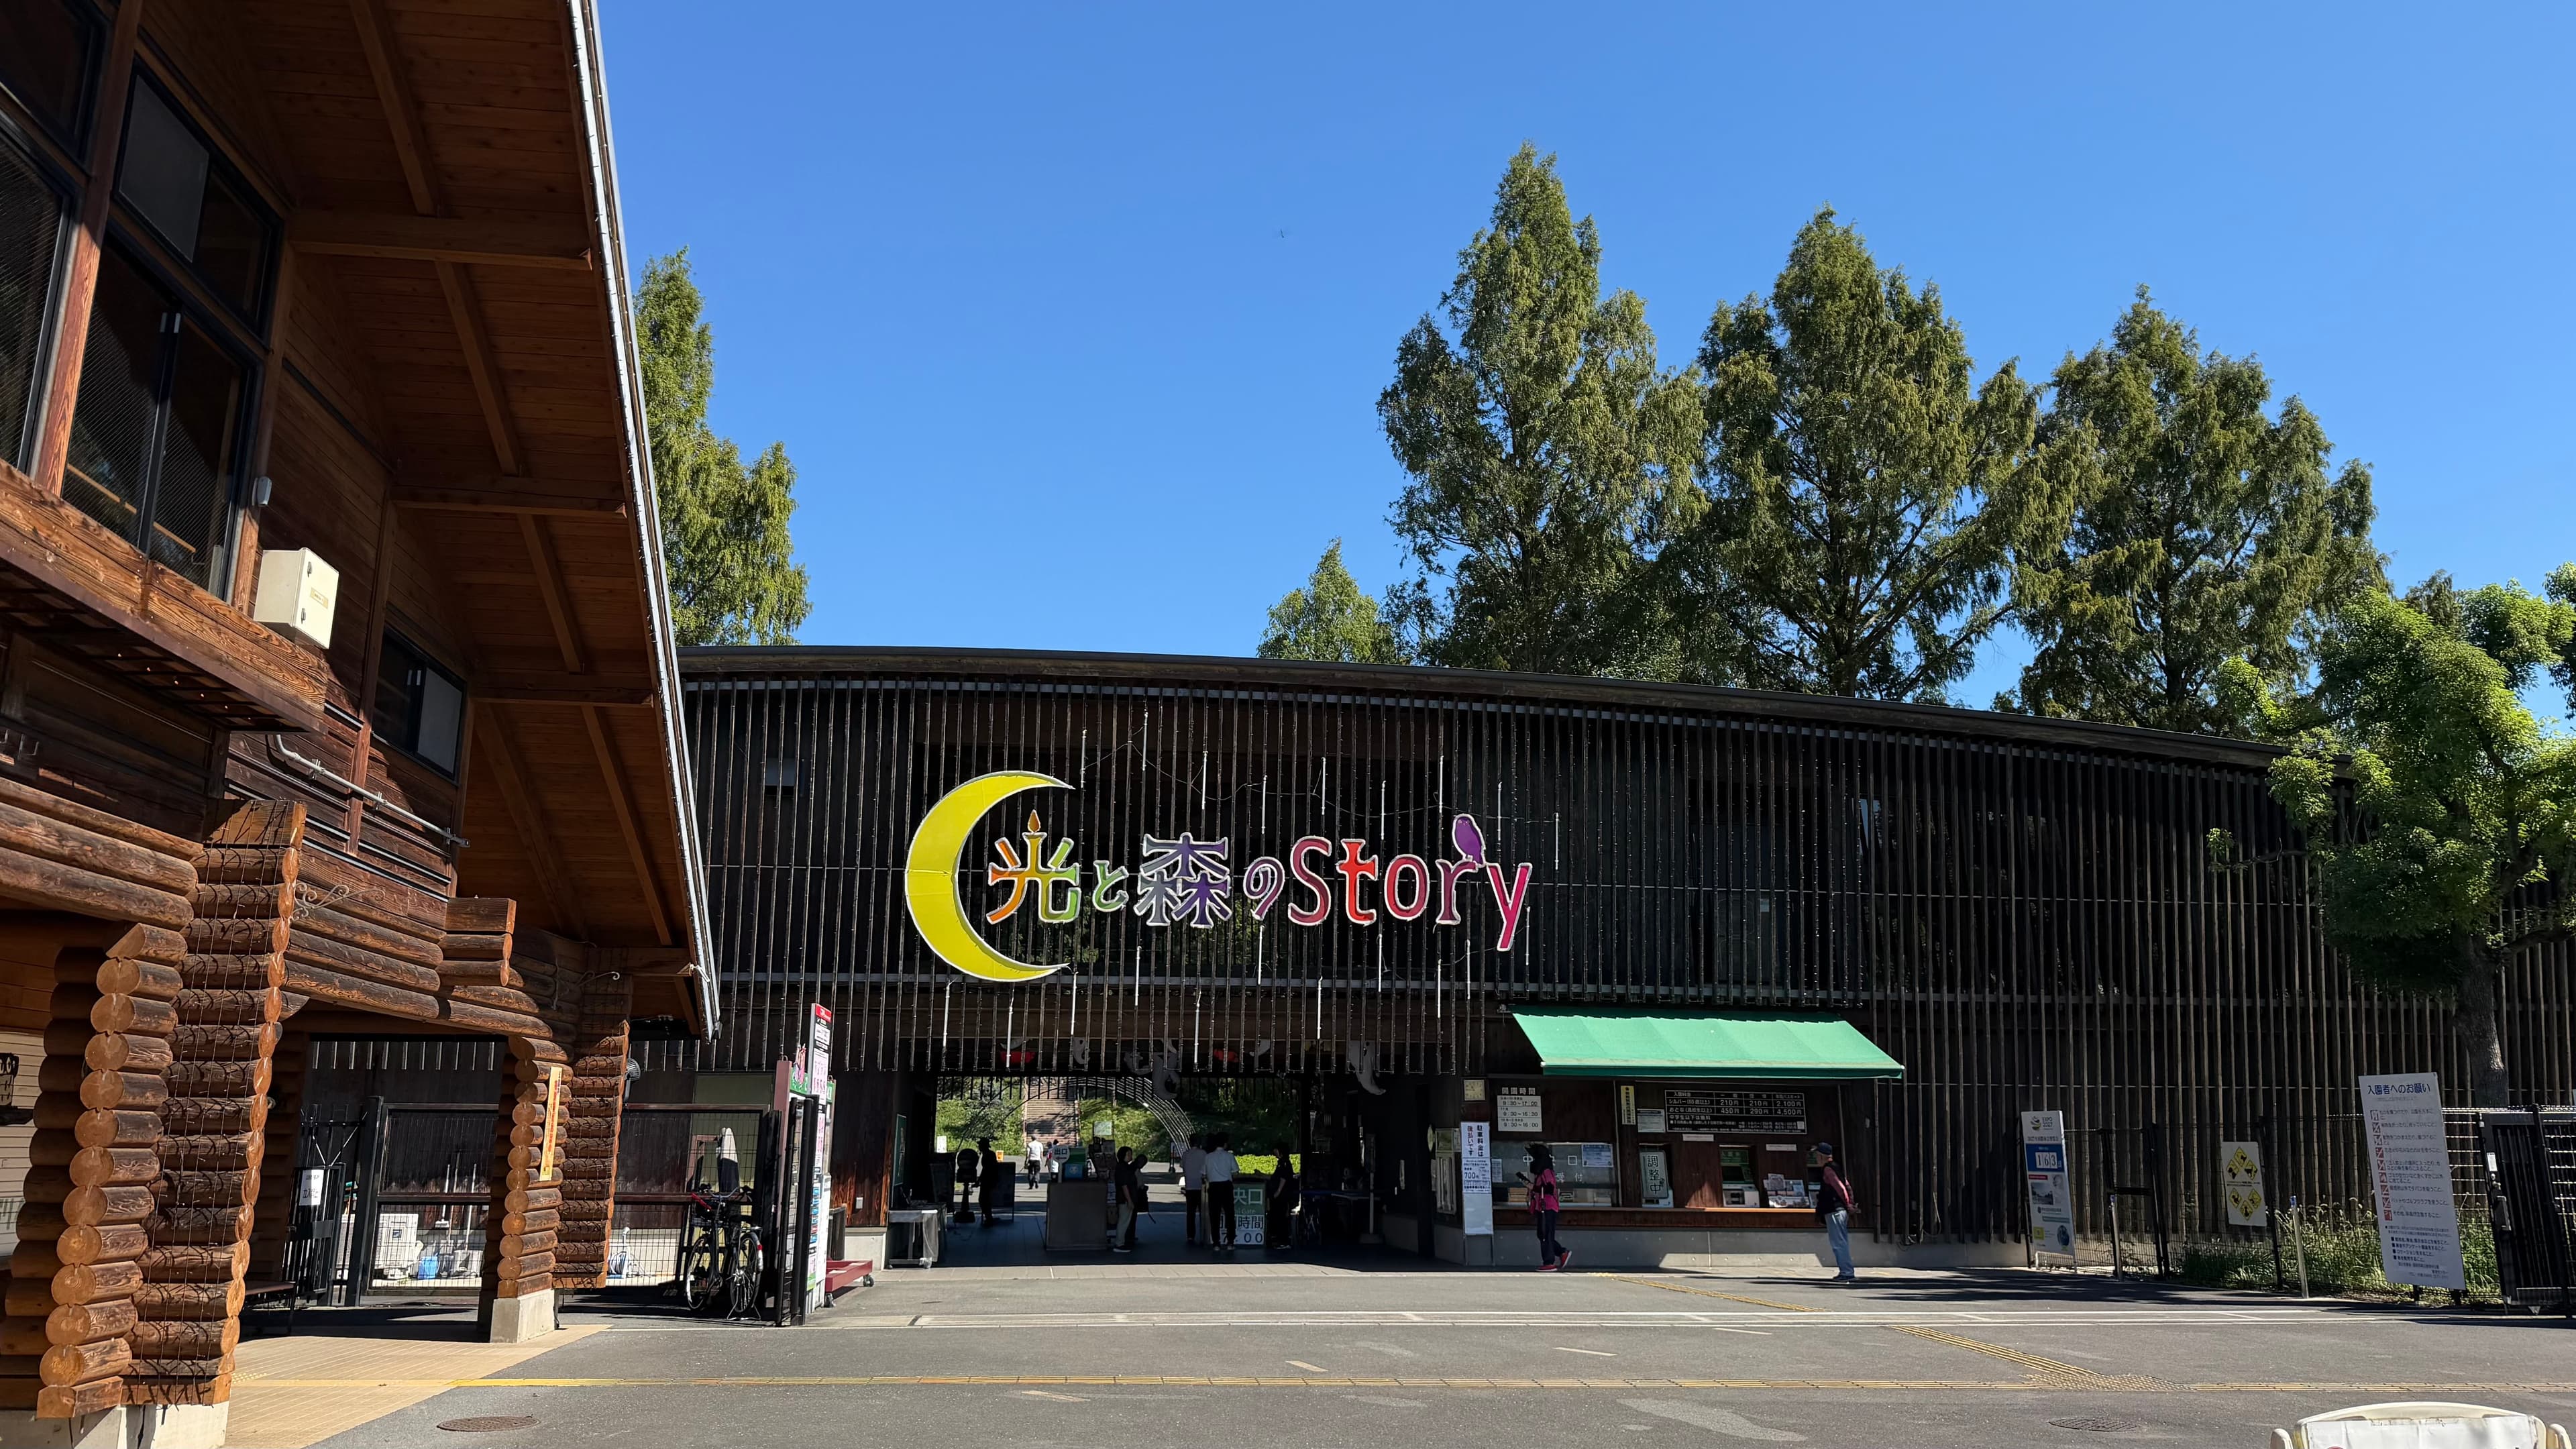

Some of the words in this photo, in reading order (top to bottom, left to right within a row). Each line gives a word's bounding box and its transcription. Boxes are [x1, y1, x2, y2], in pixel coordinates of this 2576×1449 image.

[2367, 1083, 2431, 1095] 入園者へのお願い
[2038, 1154, 2056, 1167] 163
[1647, 1155, 1662, 1194] 調整中
[1234, 1187, 1263, 1205] 央口
